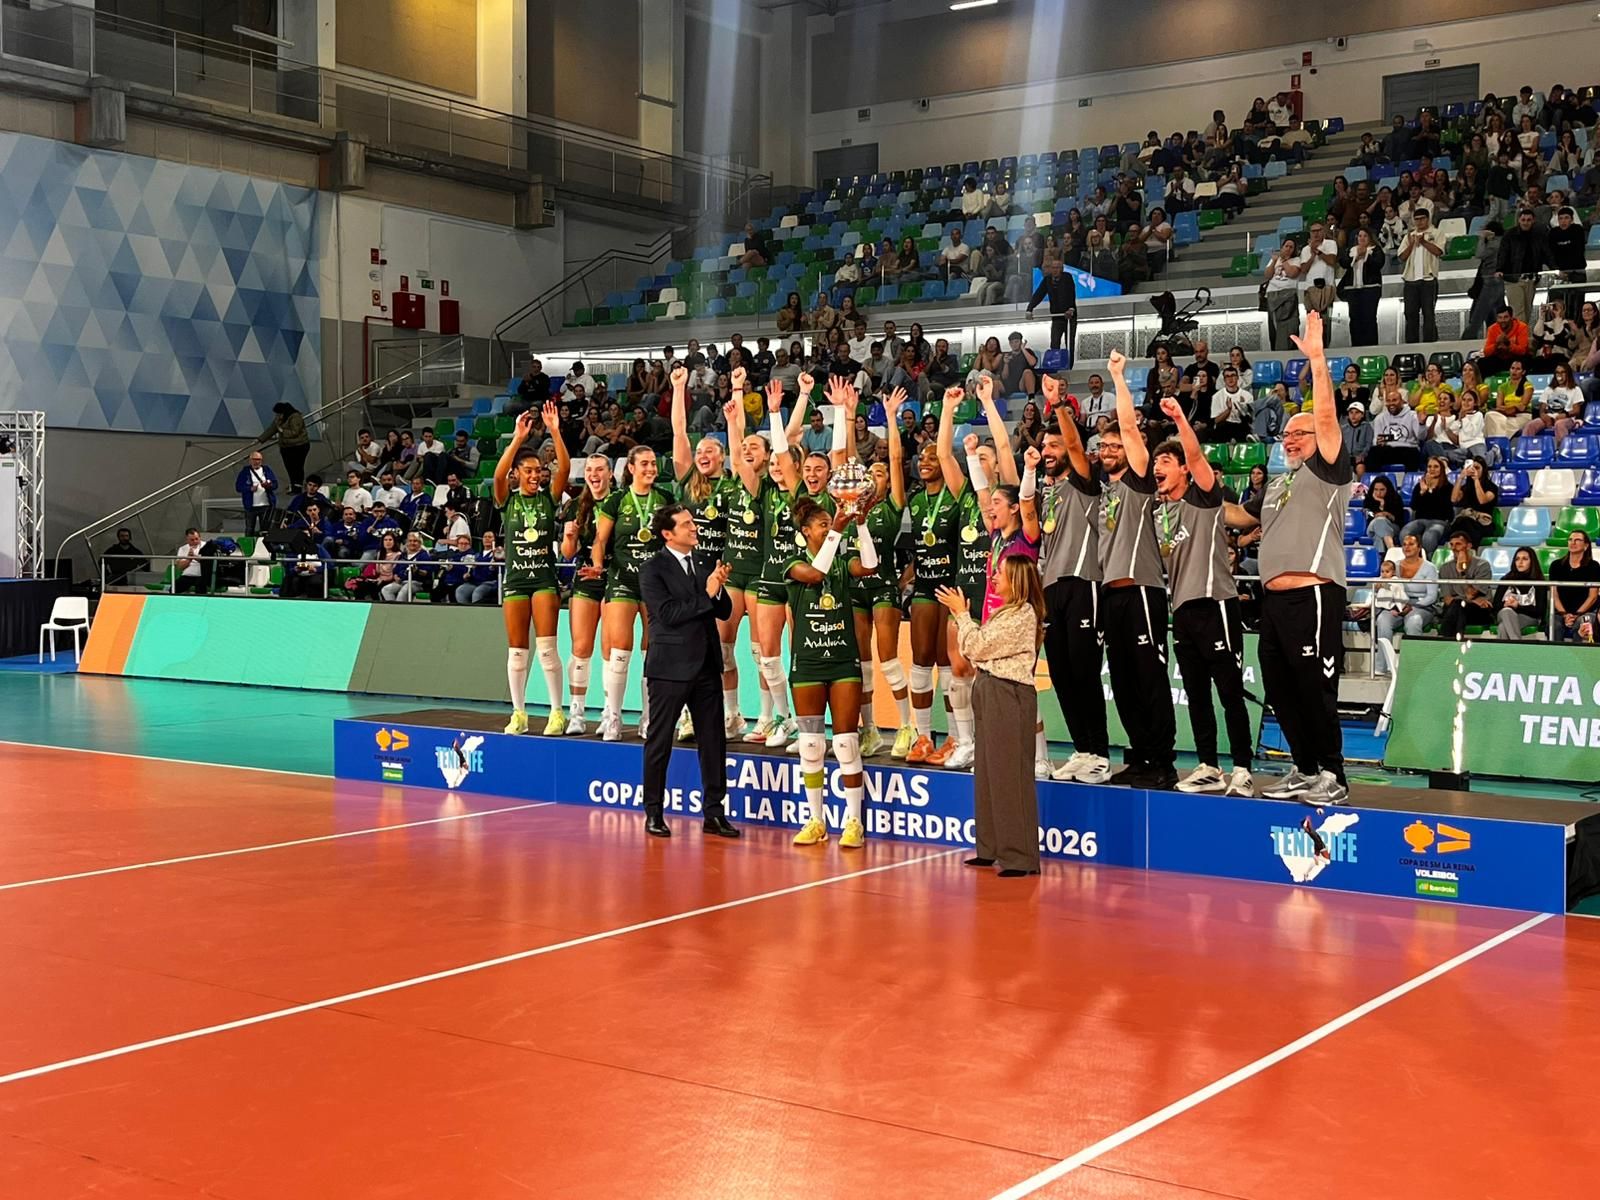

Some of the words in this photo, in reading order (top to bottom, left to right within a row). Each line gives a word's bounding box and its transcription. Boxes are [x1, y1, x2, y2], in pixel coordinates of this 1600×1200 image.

[697, 525, 727, 539] Cajaso
[730, 524, 758, 539] Cajasol
[516, 545, 548, 559] Cajasol
[632, 549, 655, 561] Cajas
[963, 547, 990, 562] Cajaso
[810, 620, 845, 635] Cajasol
[1462, 672, 1583, 706] SANTA
[435, 746, 484, 773] TENEIFE
[588, 780, 644, 806] COPA
[745, 796, 775, 821] LA
[866, 808, 976, 844] IBERDRO
[1399, 858, 1418, 867] COPA
[1420, 859, 1429, 867] DE
[1453, 863, 1476, 872] REINA
